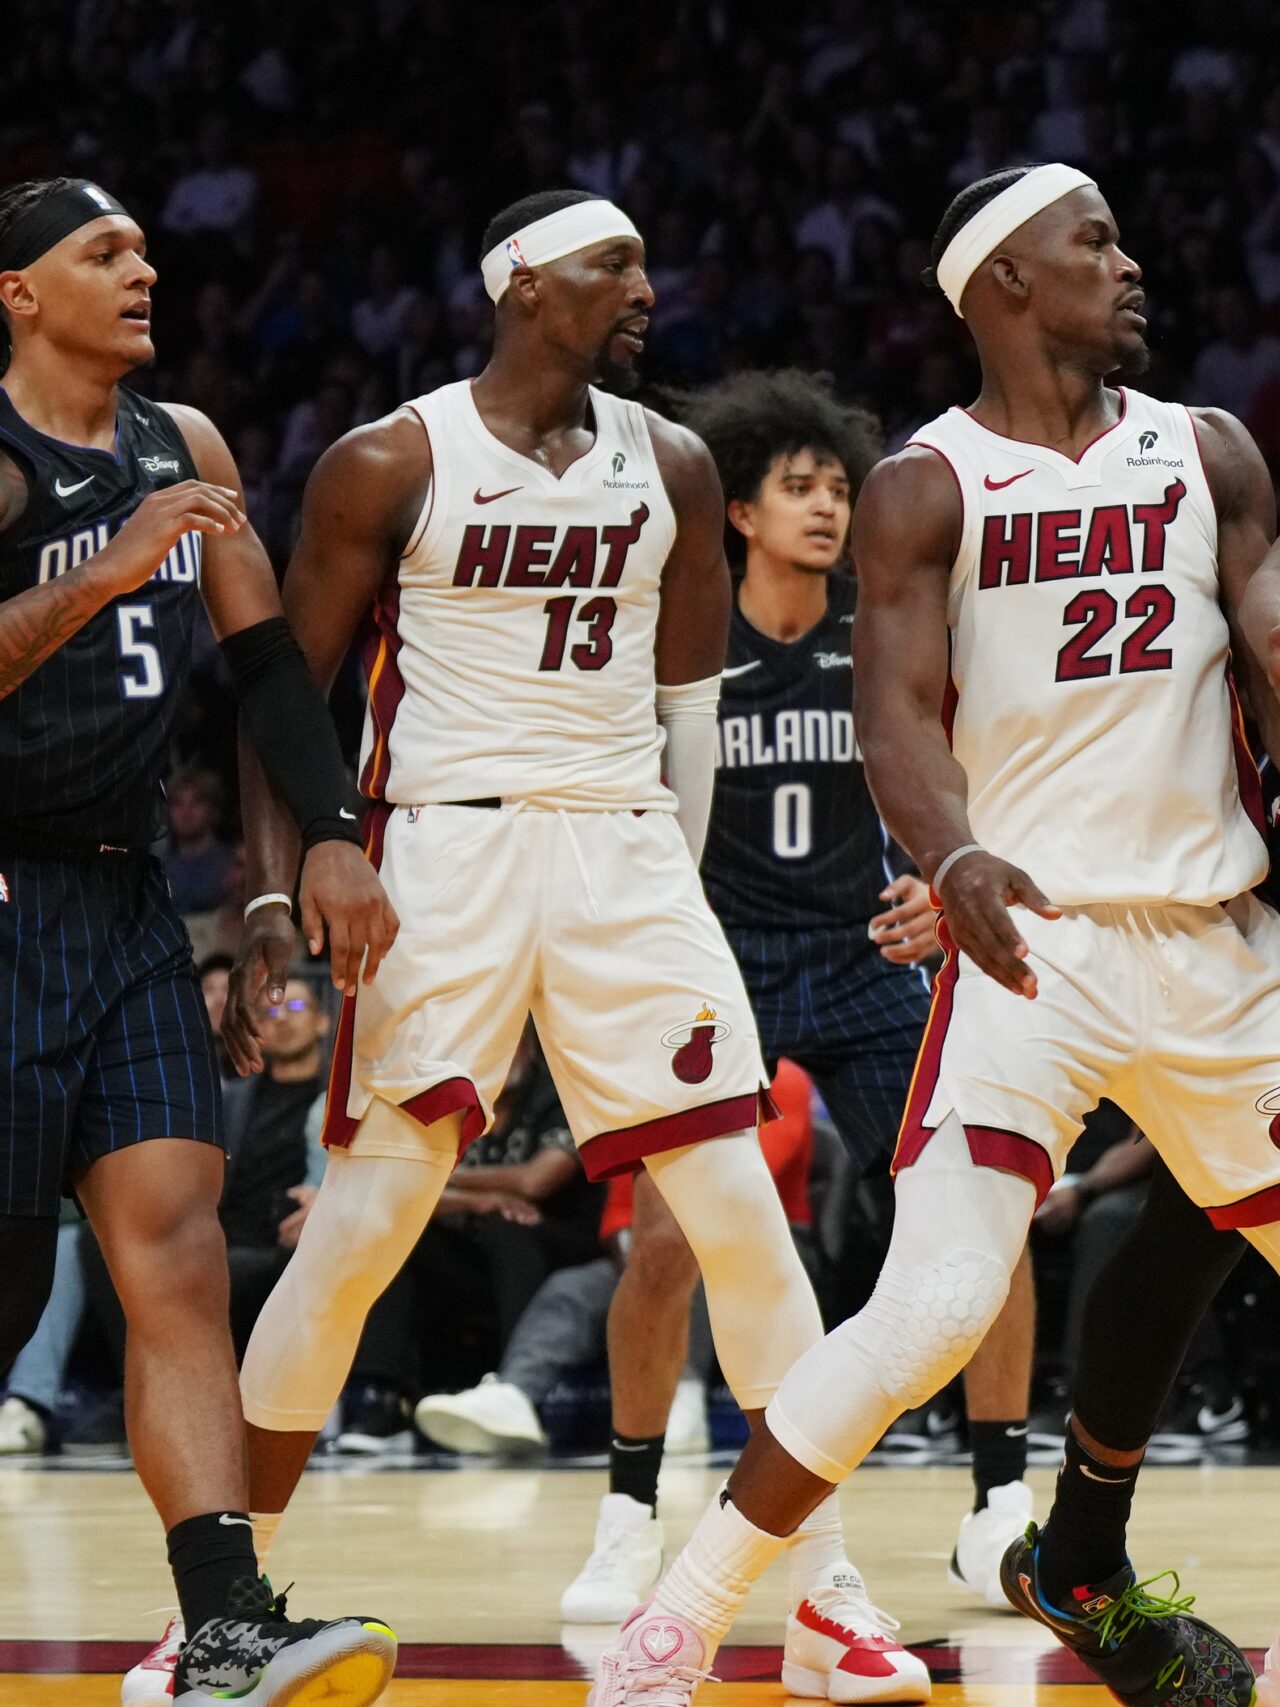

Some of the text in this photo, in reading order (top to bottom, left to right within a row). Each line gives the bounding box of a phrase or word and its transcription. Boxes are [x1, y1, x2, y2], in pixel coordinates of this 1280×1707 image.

[138, 456, 179, 473] Disney
[603, 480, 650, 489] Robinhood
[1126, 457, 1184, 468] Robinhood
[452, 501, 650, 588] HEAT
[978, 476, 1187, 590] HEAT
[117, 605, 163, 697] 5
[538, 596, 618, 671] 13
[1055, 584, 1176, 683] 22
[714, 709, 865, 768] RLAND
[774, 783, 811, 858] 0
